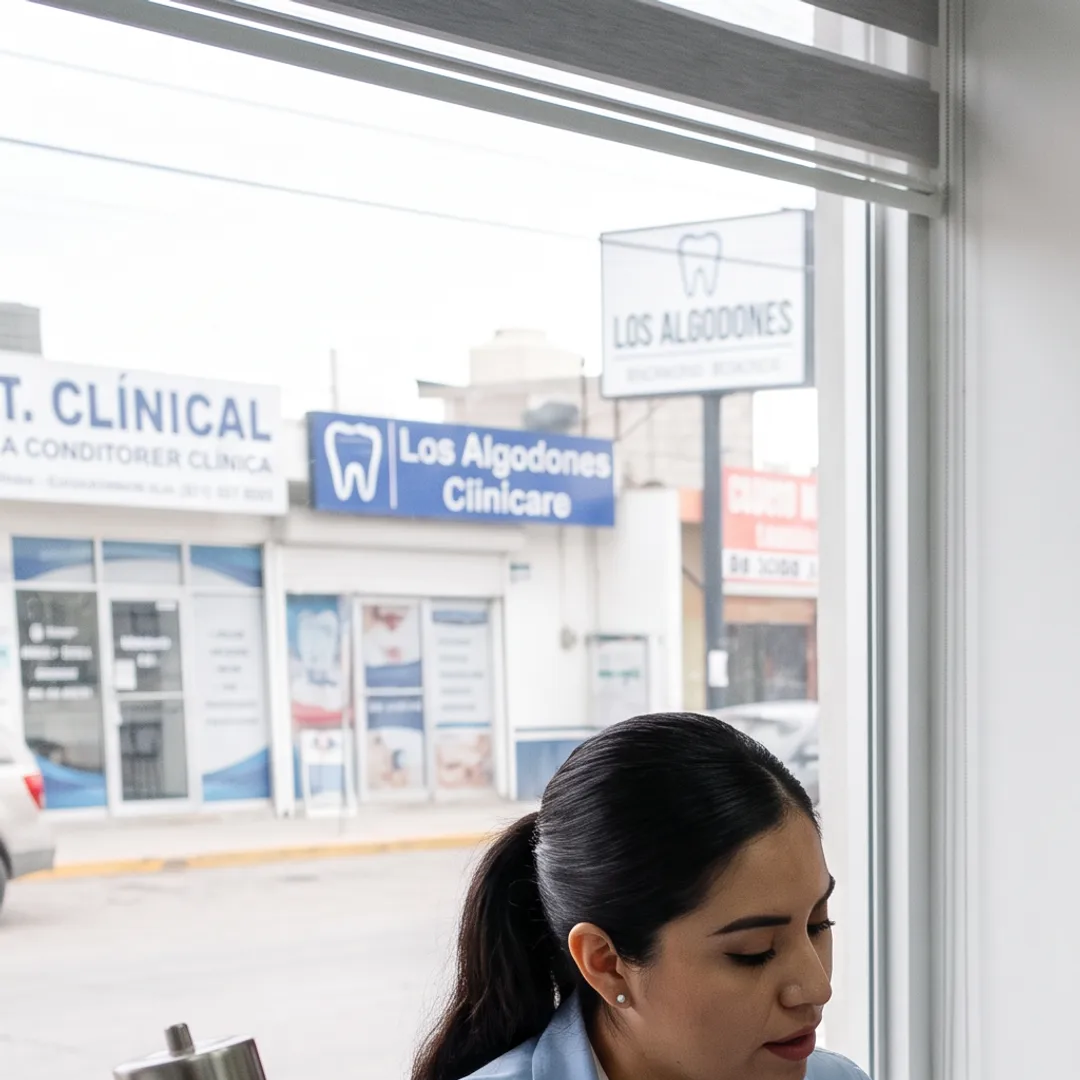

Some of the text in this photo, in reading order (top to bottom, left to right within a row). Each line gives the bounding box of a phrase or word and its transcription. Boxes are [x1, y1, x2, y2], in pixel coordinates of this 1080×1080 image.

[613, 300, 794, 349] LOS ALGODONES
[52, 373, 272, 442] CLÍNICAL
[399, 427, 612, 479] Los Algodones
